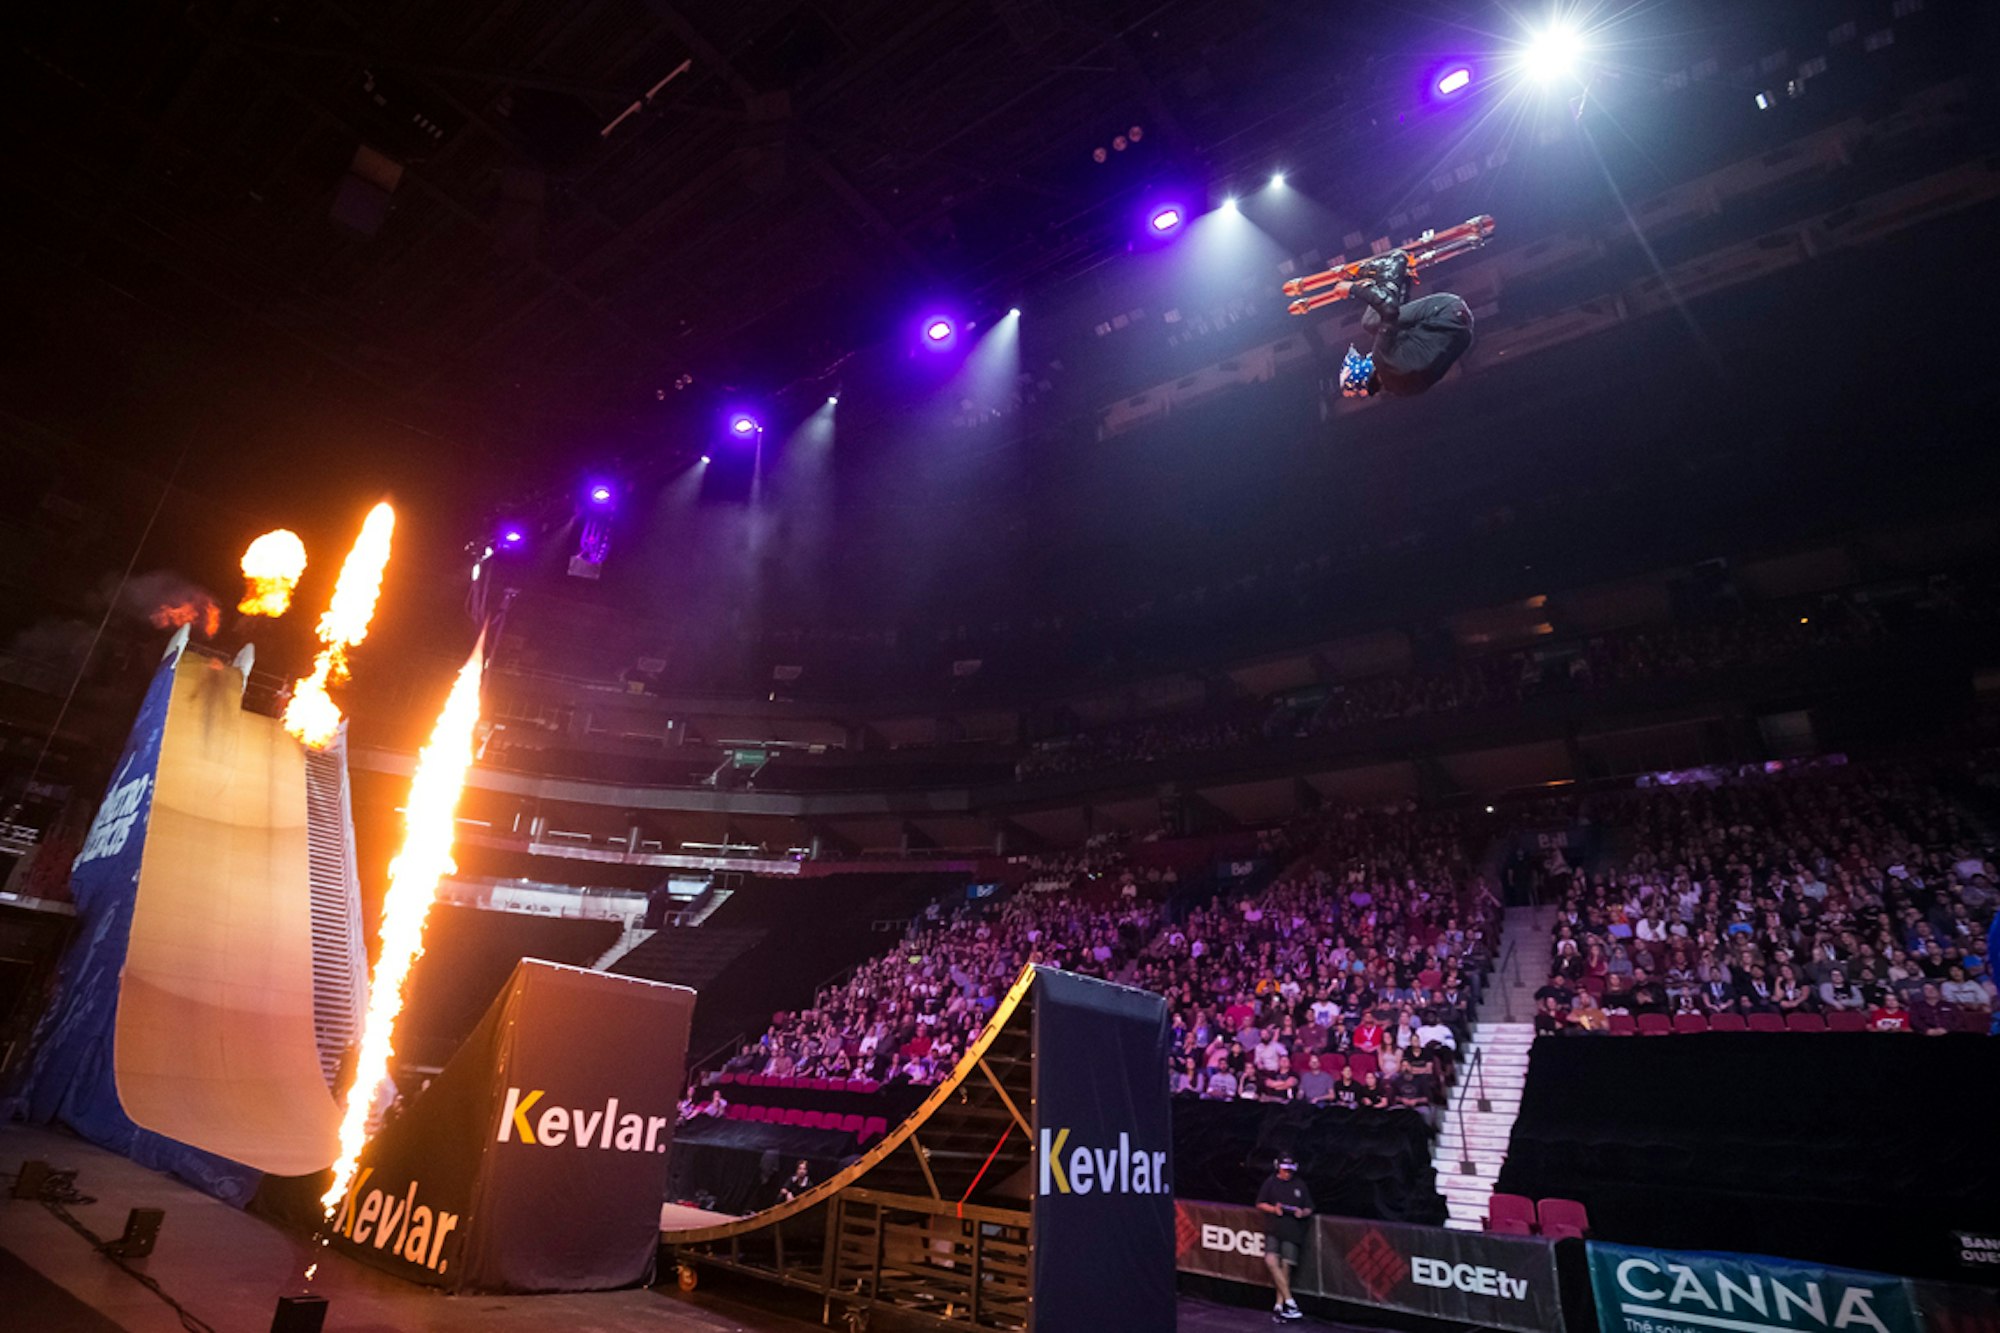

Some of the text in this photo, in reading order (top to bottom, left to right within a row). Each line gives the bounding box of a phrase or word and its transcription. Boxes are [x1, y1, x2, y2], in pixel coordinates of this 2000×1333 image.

[1960, 1236, 2000, 1250] BAN
[1961, 1250, 2000, 1264] OUE
[1410, 1256, 1528, 1301] EDGEtv
[1616, 1258, 1889, 1333] CANNA
